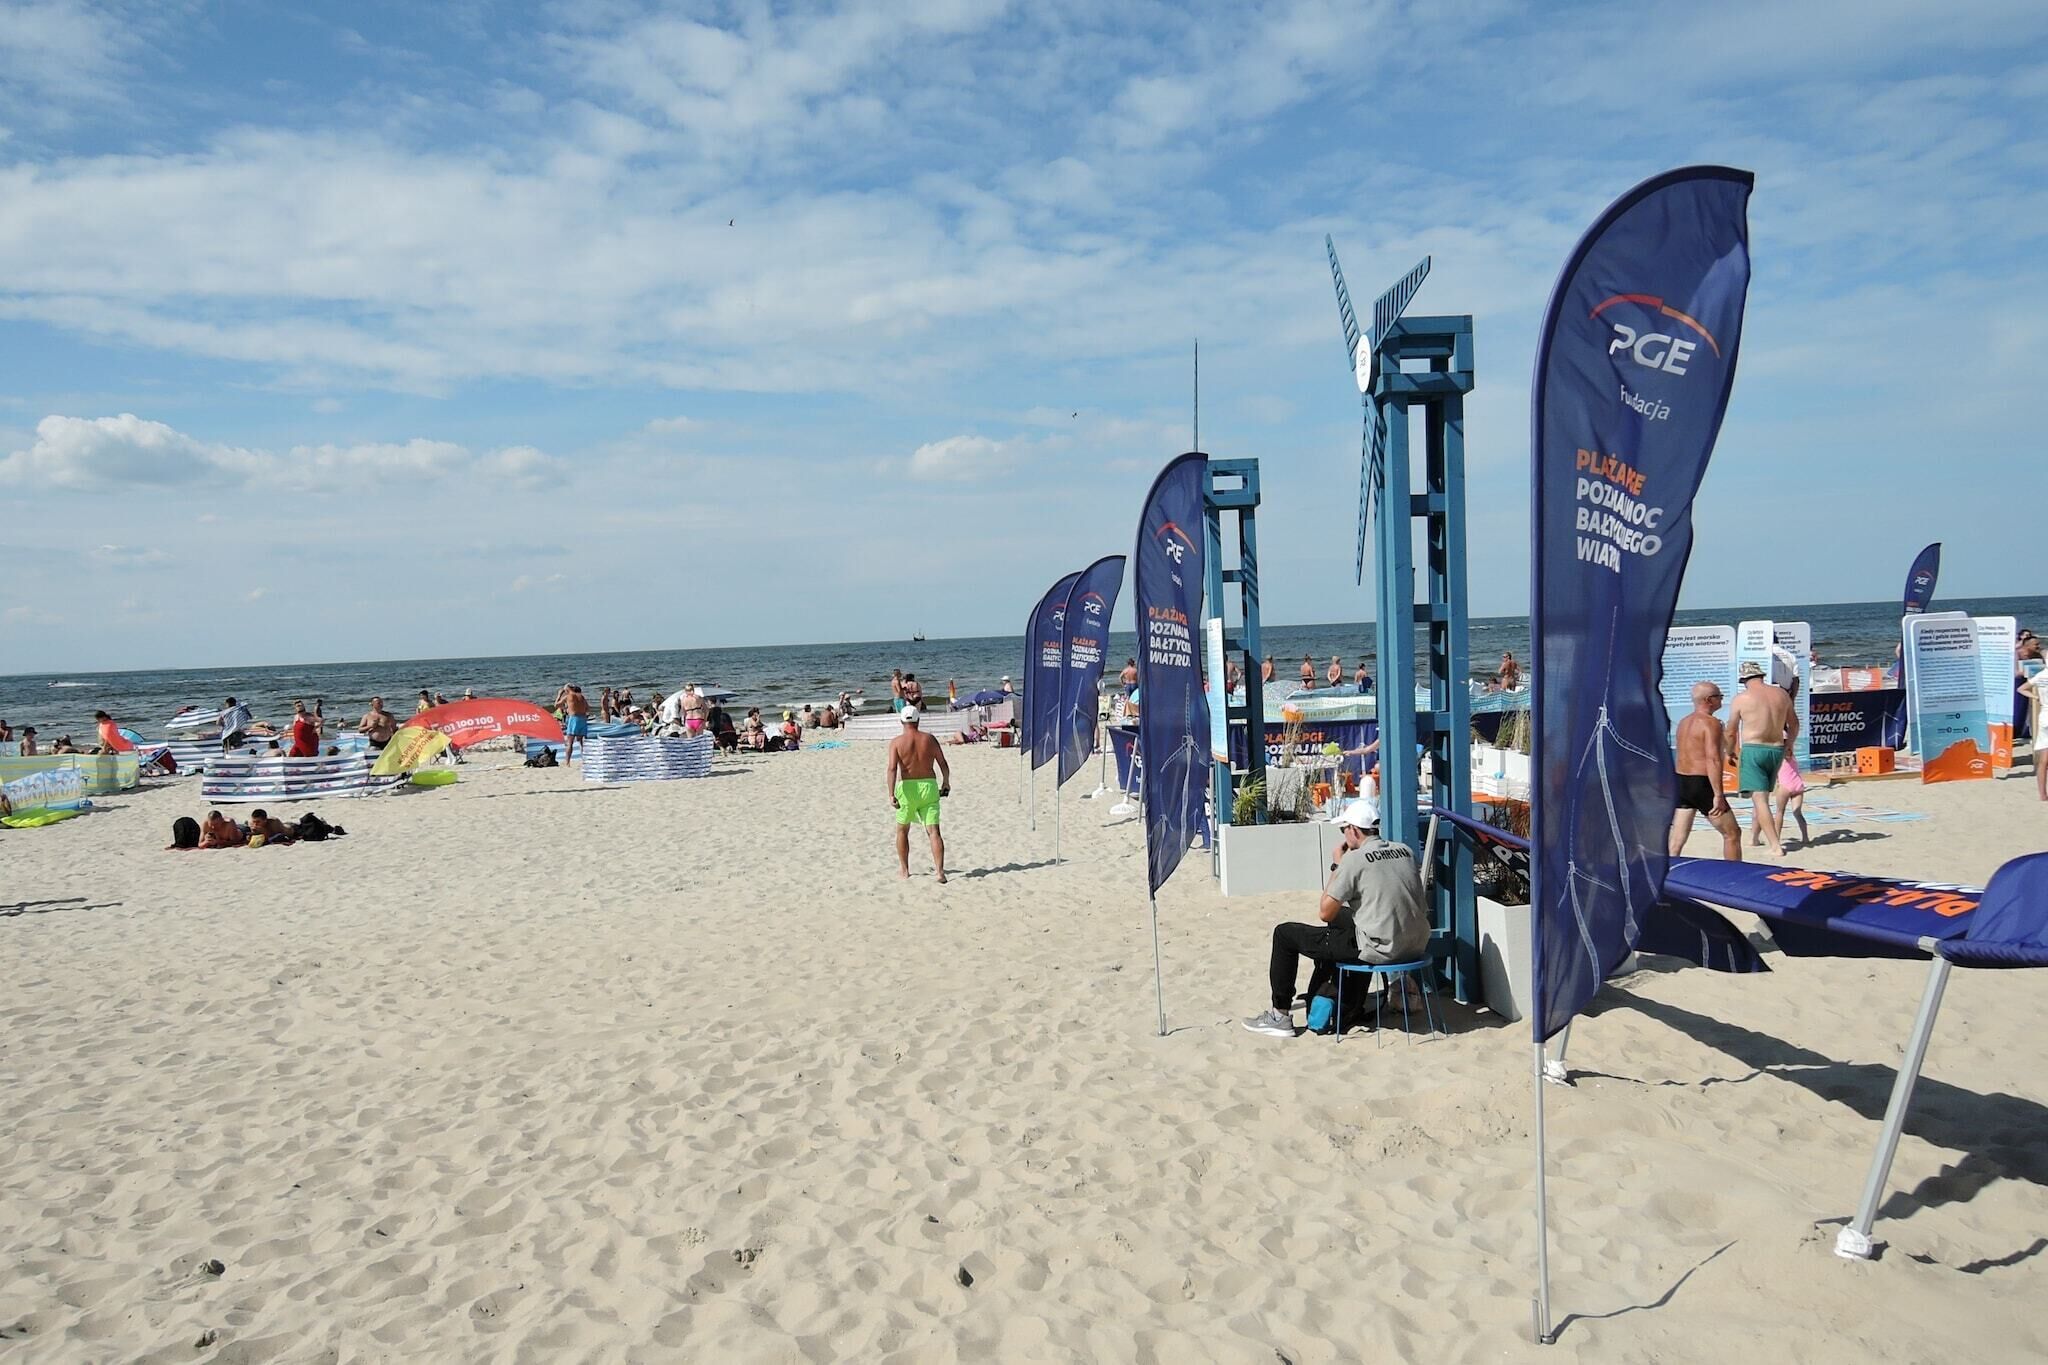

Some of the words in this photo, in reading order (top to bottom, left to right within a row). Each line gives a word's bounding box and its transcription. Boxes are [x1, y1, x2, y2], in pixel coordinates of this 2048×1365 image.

[1608, 324, 1696, 376] PGE
[507, 713, 531, 726] plus
[1837, 712, 1865, 721] MOC
[1365, 848, 1411, 863] OCHRONA
